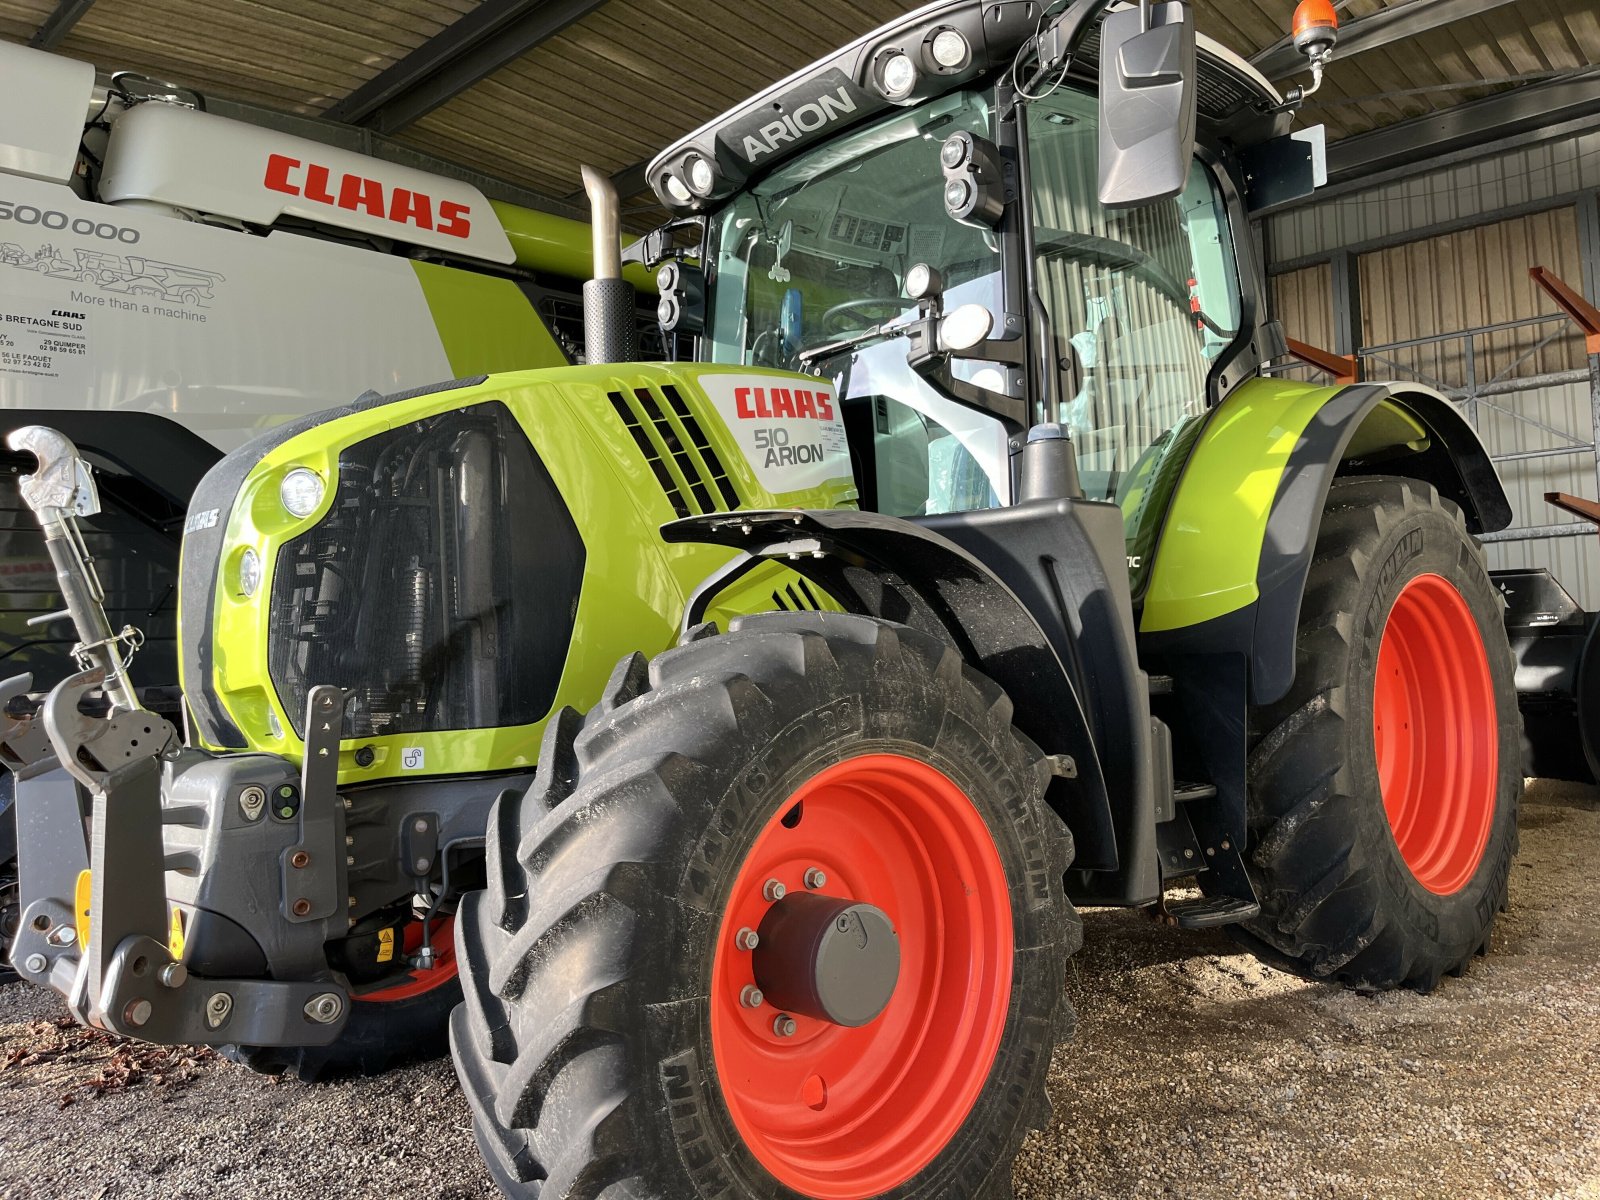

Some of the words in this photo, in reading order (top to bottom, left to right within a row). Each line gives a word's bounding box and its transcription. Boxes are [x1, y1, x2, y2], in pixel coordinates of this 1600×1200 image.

[743, 86, 857, 163] ARION
[264, 153, 471, 239] CLAAS
[51, 309, 86, 320] CLAAS
[71, 290, 105, 306] More
[109, 295, 138, 312] than
[142, 304, 150, 314] a
[154, 304, 207, 323] machine
[5, 314, 60, 329] BRETAGNE
[62, 322, 83, 331] SUD
[53, 340, 86, 349] QUIMPER
[734, 387, 834, 420] CLAAS
[754, 427, 789, 449] 510
[764, 444, 824, 469] ARION
[970, 739, 1049, 900] MICHELIN
